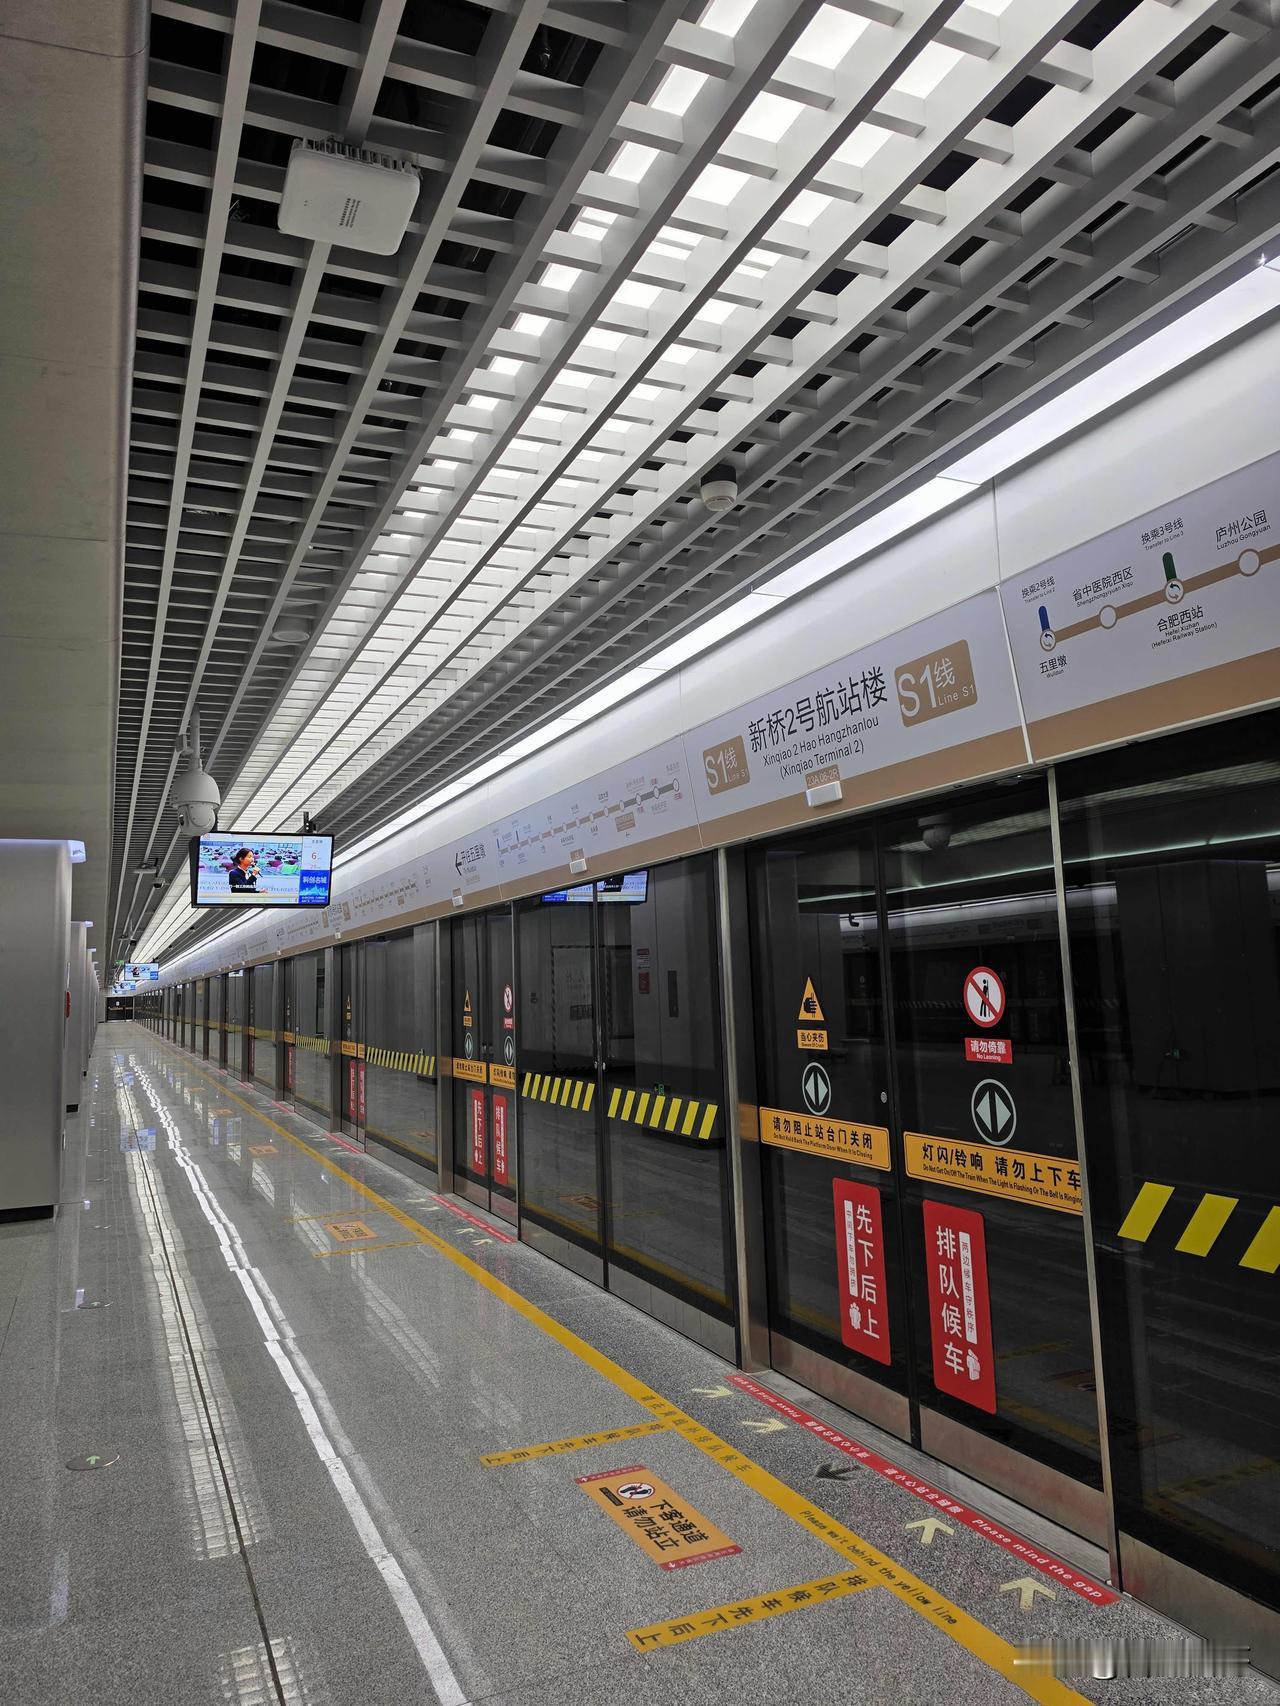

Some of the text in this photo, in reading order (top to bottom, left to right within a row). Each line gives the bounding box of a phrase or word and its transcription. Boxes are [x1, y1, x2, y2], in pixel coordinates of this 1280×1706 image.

[1141, 517, 1184, 545] 换乘3号线
[1215, 509, 1268, 542] 庐州公园
[1216, 524, 1271, 550] Luzhou Gongyuan
[1021, 576, 1055, 599] 换乘2号线
[1072, 567, 1133, 602] 省中医院西区
[1157, 605, 1204, 632] 合肥西站
[1165, 621, 1200, 637] Hefei Xizhan
[1172, 628, 1194, 642] Railway
[1195, 621, 1218, 635] Station)
[1039, 655, 1067, 674] 五里墩
[898, 657, 956, 718] S1线
[938, 684, 975, 706] Line S1
[748, 666, 888, 753] 新桥2号航站楼
[763, 716, 879, 767] Xinqiao 2 Hao Hangzhanlou
[705, 747, 740, 789] S1线
[779, 738, 864, 781] (Xinqiao Terminal 2)
[800, 1032, 824, 1043] 当心夹伤
[970, 1039, 1007, 1055] 请勿倚靠
[984, 1054, 1001, 1062] Leaning
[773, 1117, 872, 1149] 请勿阻止站台门关闭
[857, 1150, 873, 1160] Closing
[922, 1142, 1081, 1191] 灯闪/铃响 请勿上下车
[965, 1172, 975, 1180] Train
[976, 1175, 988, 1183] When
[997, 1179, 1008, 1188] Light
[1014, 1182, 1032, 1193] Flashing
[1040, 1188, 1048, 1196] The
[1049, 1190, 1058, 1198] Bell
[857, 1205, 879, 1339] 先下后上
[936, 1225, 965, 1375] 排队候车
[621, 1504, 681, 1551] 请勿站立
[649, 1499, 710, 1545] 下客通道
[799, 1510, 957, 1625] Please wait behind the yellow line
[972, 1519, 1102, 1599] Please mind the gap
[635, 1574, 868, 1646] 排队候车先下后上
